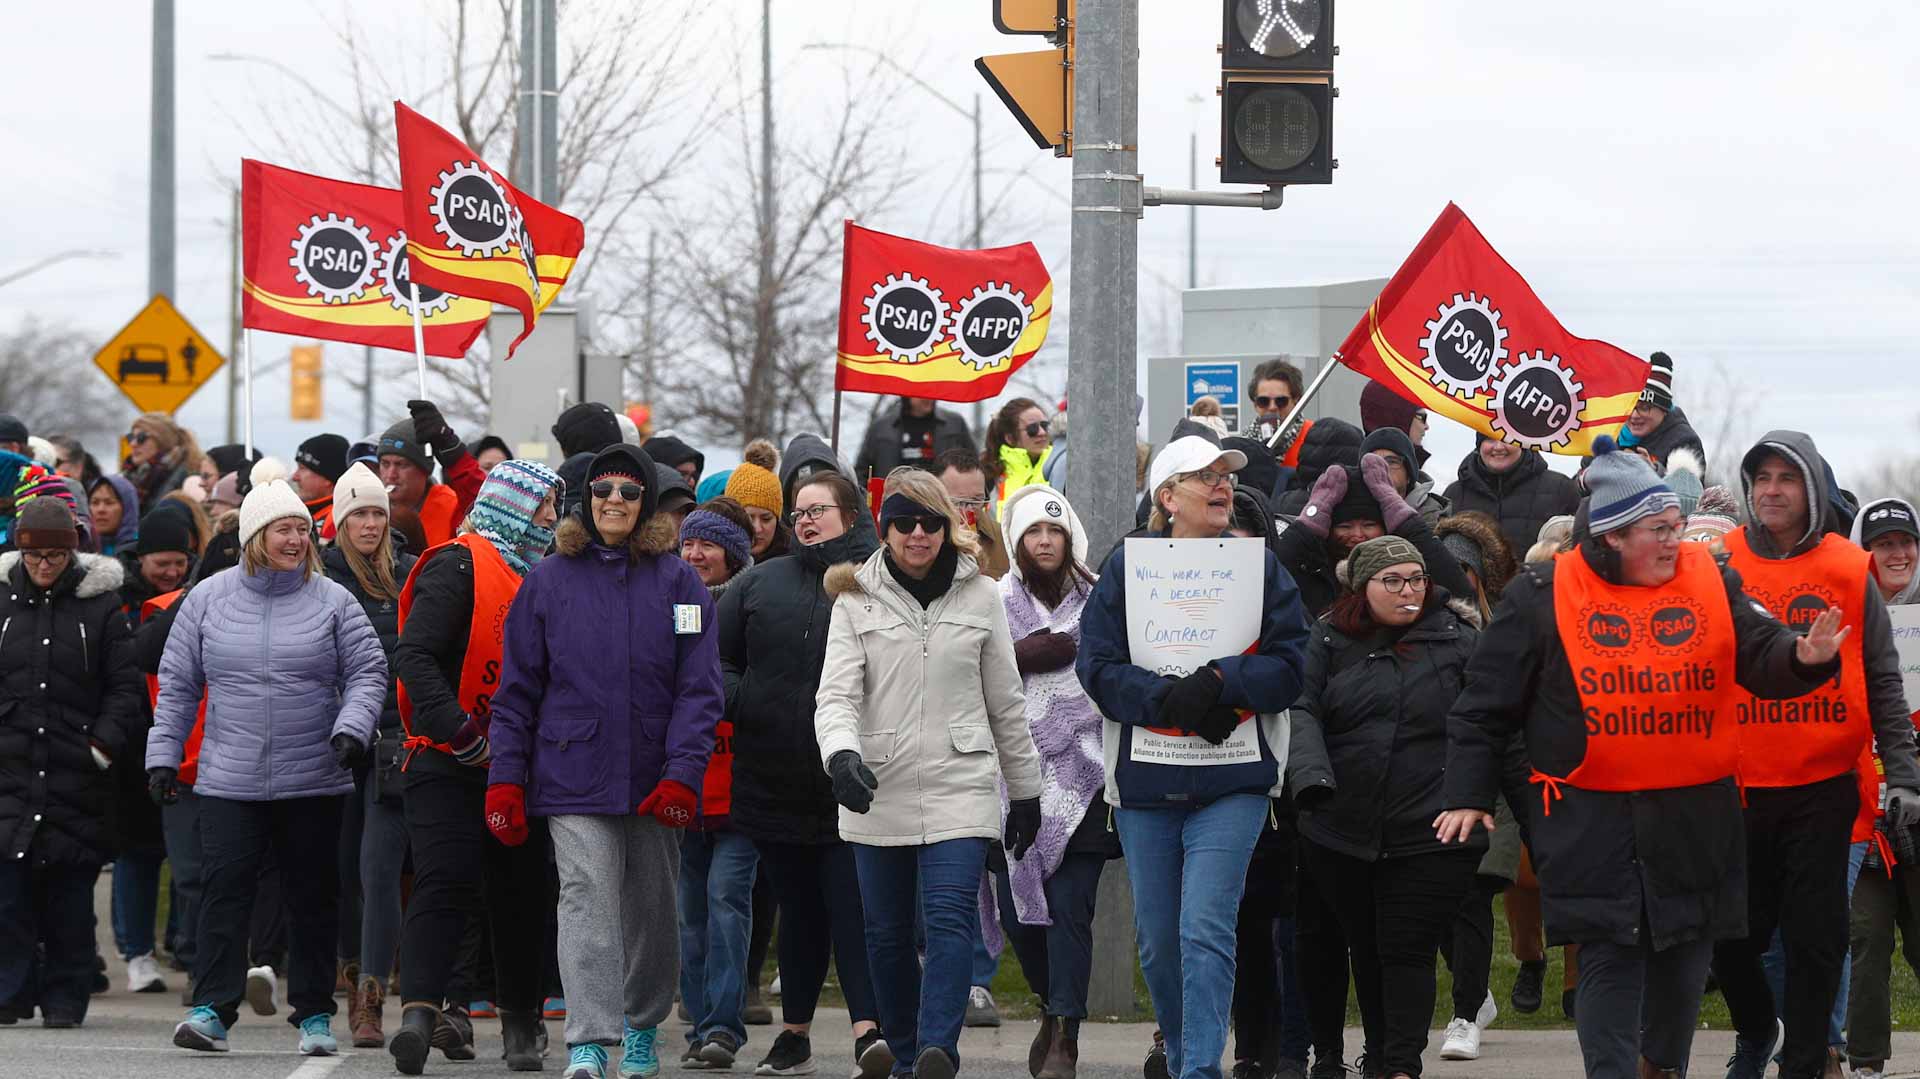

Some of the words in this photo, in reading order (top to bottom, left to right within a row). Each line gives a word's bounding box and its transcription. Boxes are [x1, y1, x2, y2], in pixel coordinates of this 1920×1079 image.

[449, 193, 505, 227] PSAC
[308, 245, 364, 273] PSAC
[880, 303, 934, 333] PSAC
[966, 317, 1022, 340] AFPC
[1442, 319, 1491, 373] PSAC
[1508, 379, 1568, 430] AFPC
[1135, 565, 1165, 581] WILL
[1172, 570, 1202, 581] WORK
[1211, 570, 1235, 581] FOR
[1150, 588, 1159, 600] A
[1170, 587, 1224, 600] DECENT
[1653, 615, 1694, 637] PSAC
[1790, 607, 1826, 624] AFP
[1145, 620, 1218, 643] CONTRACT
[1580, 661, 1716, 695] Solidarité
[1583, 704, 1715, 739] Solidarity
[1737, 694, 1847, 724] olidarité
[1133, 748, 1155, 757] Alliance
[1171, 751, 1199, 760] Fonction
[1200, 752, 1227, 761] publique
[1143, 738, 1161, 748] Public
[1163, 740, 1187, 750] Service
[1225, 740, 1246, 749] Canada
